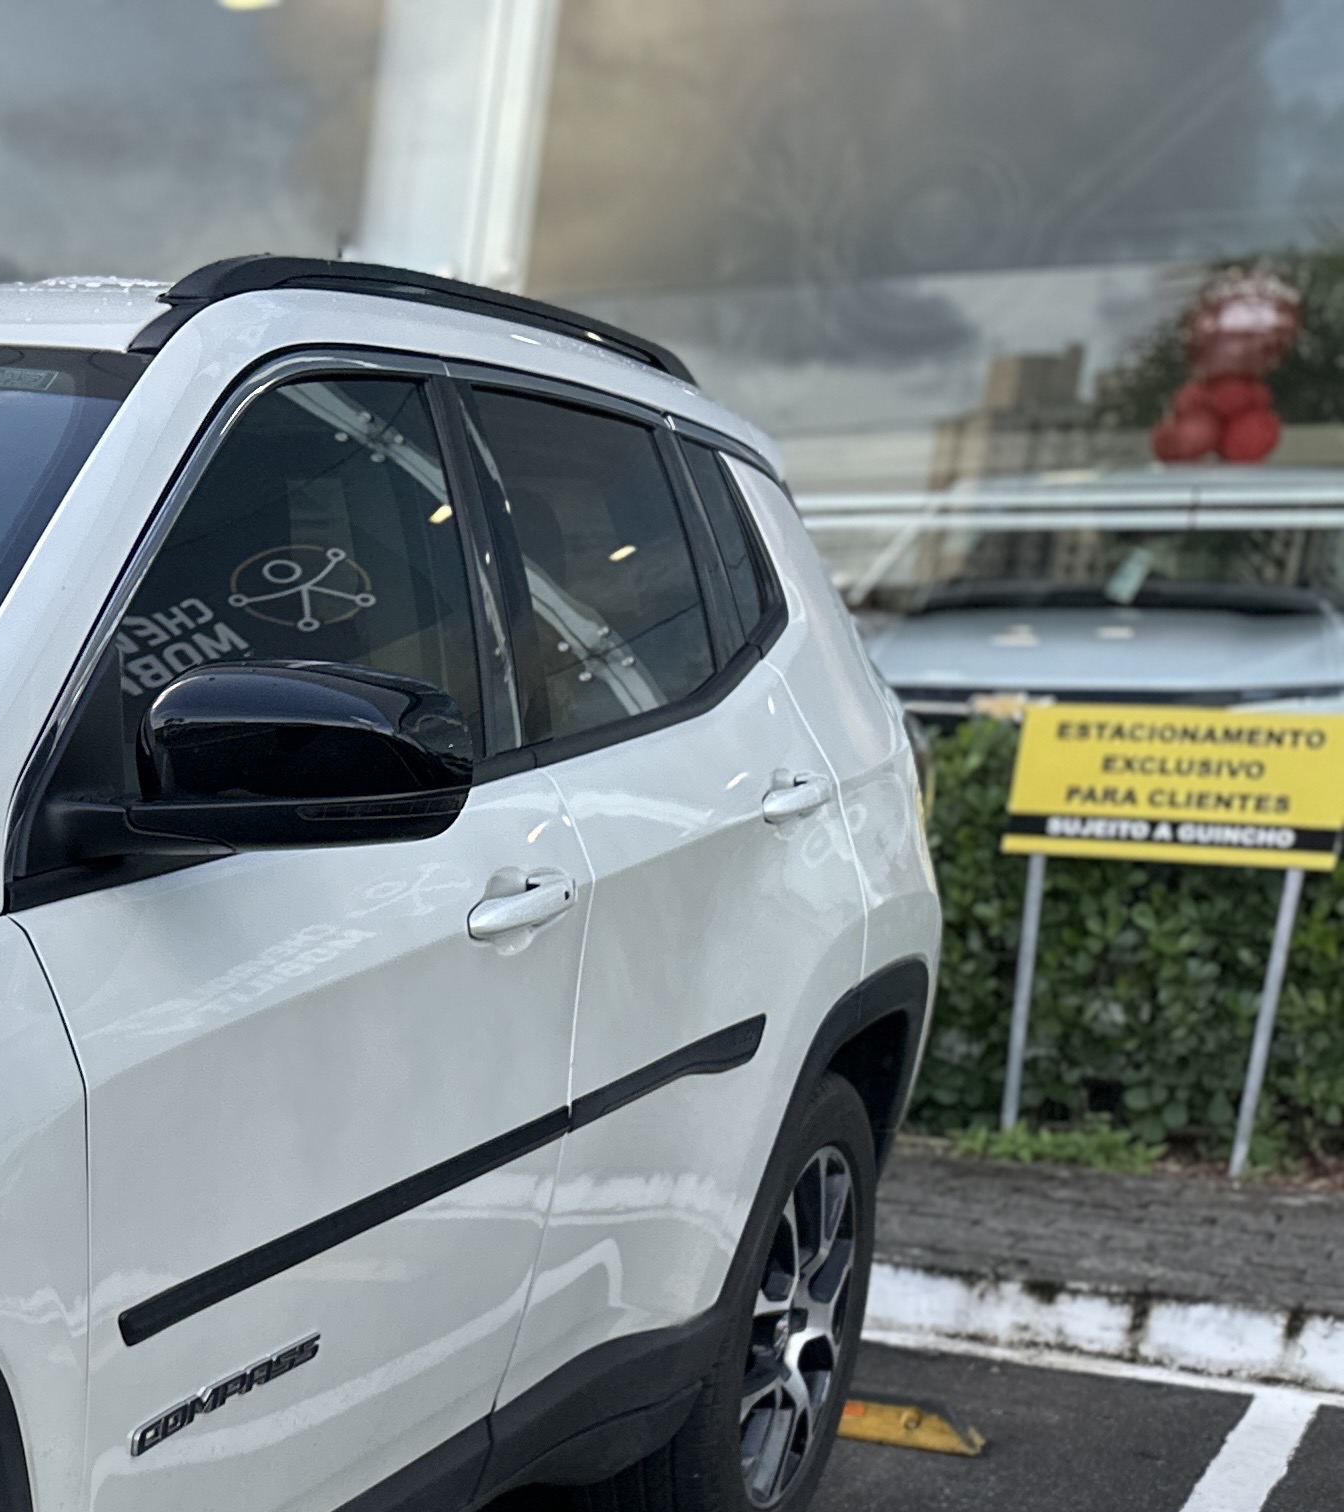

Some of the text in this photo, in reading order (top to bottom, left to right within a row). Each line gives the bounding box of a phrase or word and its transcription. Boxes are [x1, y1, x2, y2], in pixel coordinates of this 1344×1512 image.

[1056, 720, 1327, 750] ESTACIONAMENTO
[1101, 754, 1266, 780] EXCLUSIVO
[1065, 785, 1291, 813] PARA CLIENTES
[1045, 816, 1296, 849] SUJEITO A GUINCHO
[127, 1331, 322, 1457] COMPASS
